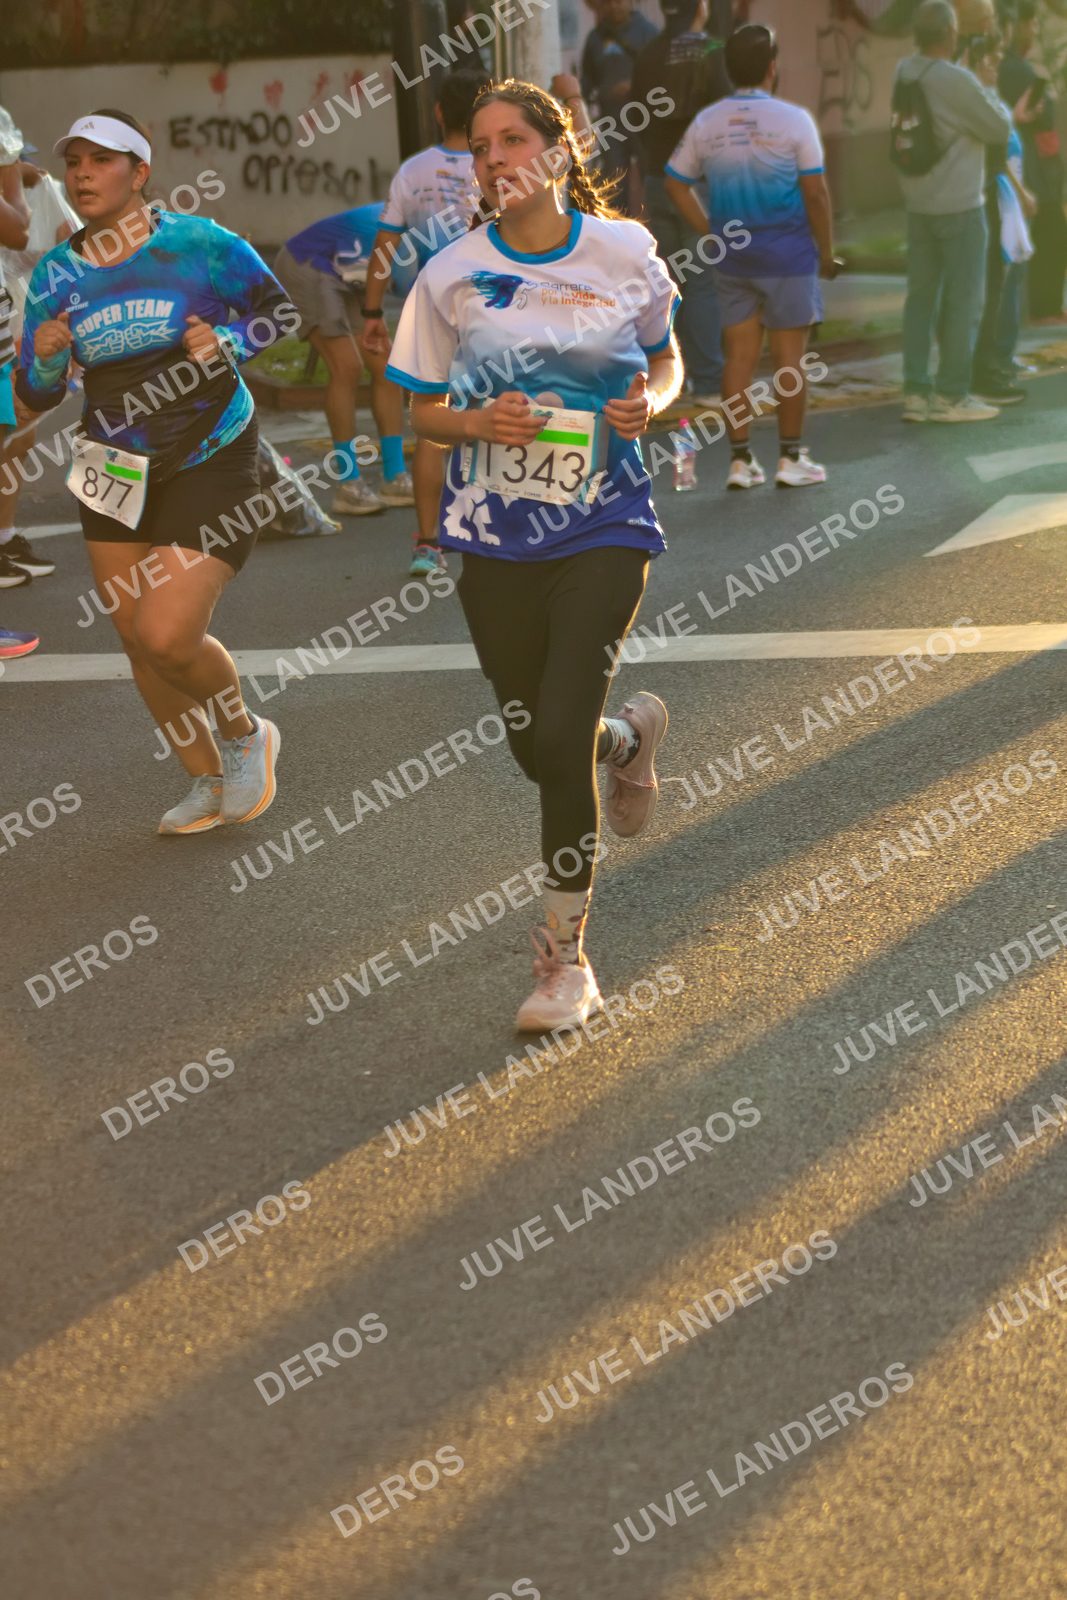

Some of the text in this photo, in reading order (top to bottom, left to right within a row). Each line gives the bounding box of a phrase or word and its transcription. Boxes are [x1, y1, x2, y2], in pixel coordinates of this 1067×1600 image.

[76, 299, 175, 338] SUPER TEAM
[82, 466, 134, 509] 877
[485, 443, 585, 493] 1343
